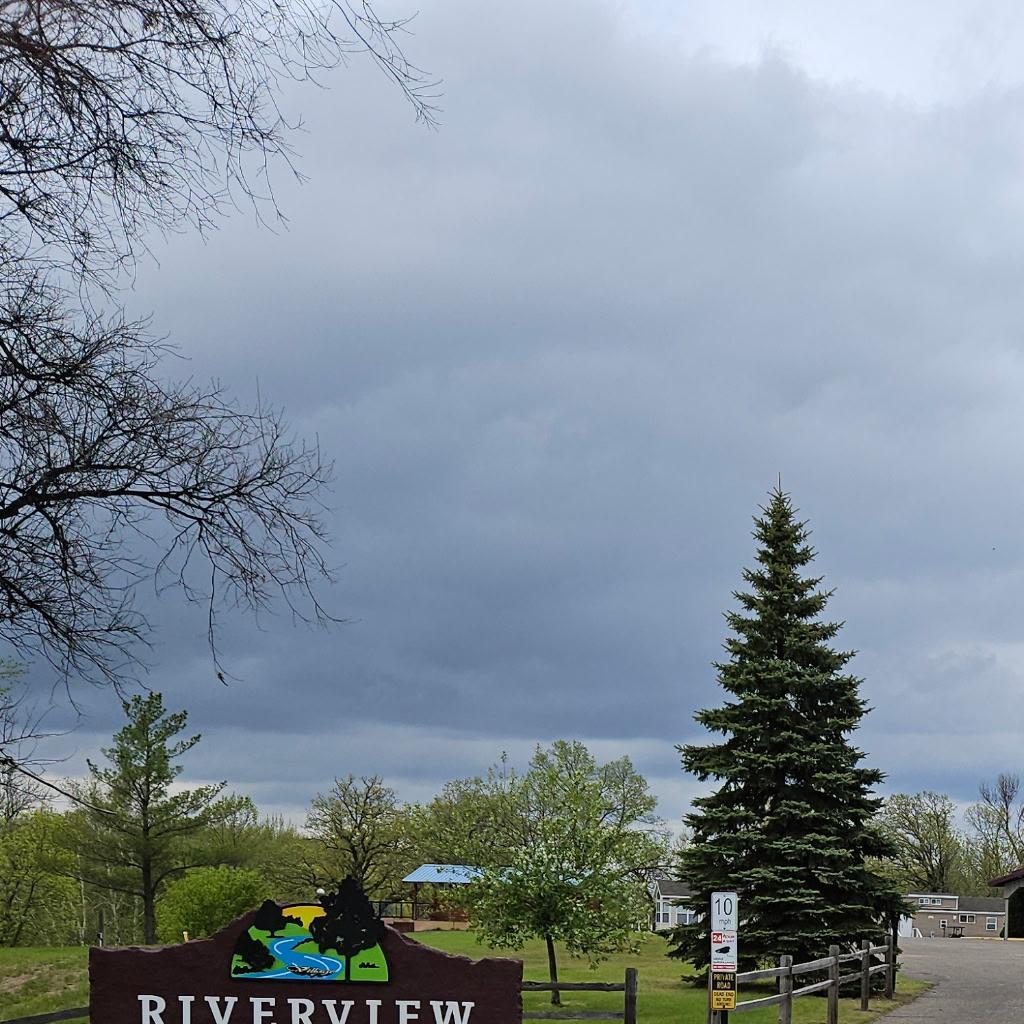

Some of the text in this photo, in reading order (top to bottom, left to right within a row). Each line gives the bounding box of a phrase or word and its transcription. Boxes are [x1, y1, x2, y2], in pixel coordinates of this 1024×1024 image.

[715, 898, 733, 916] 10
[718, 918, 732, 927] mph
[713, 973, 734, 981] PRIVATE
